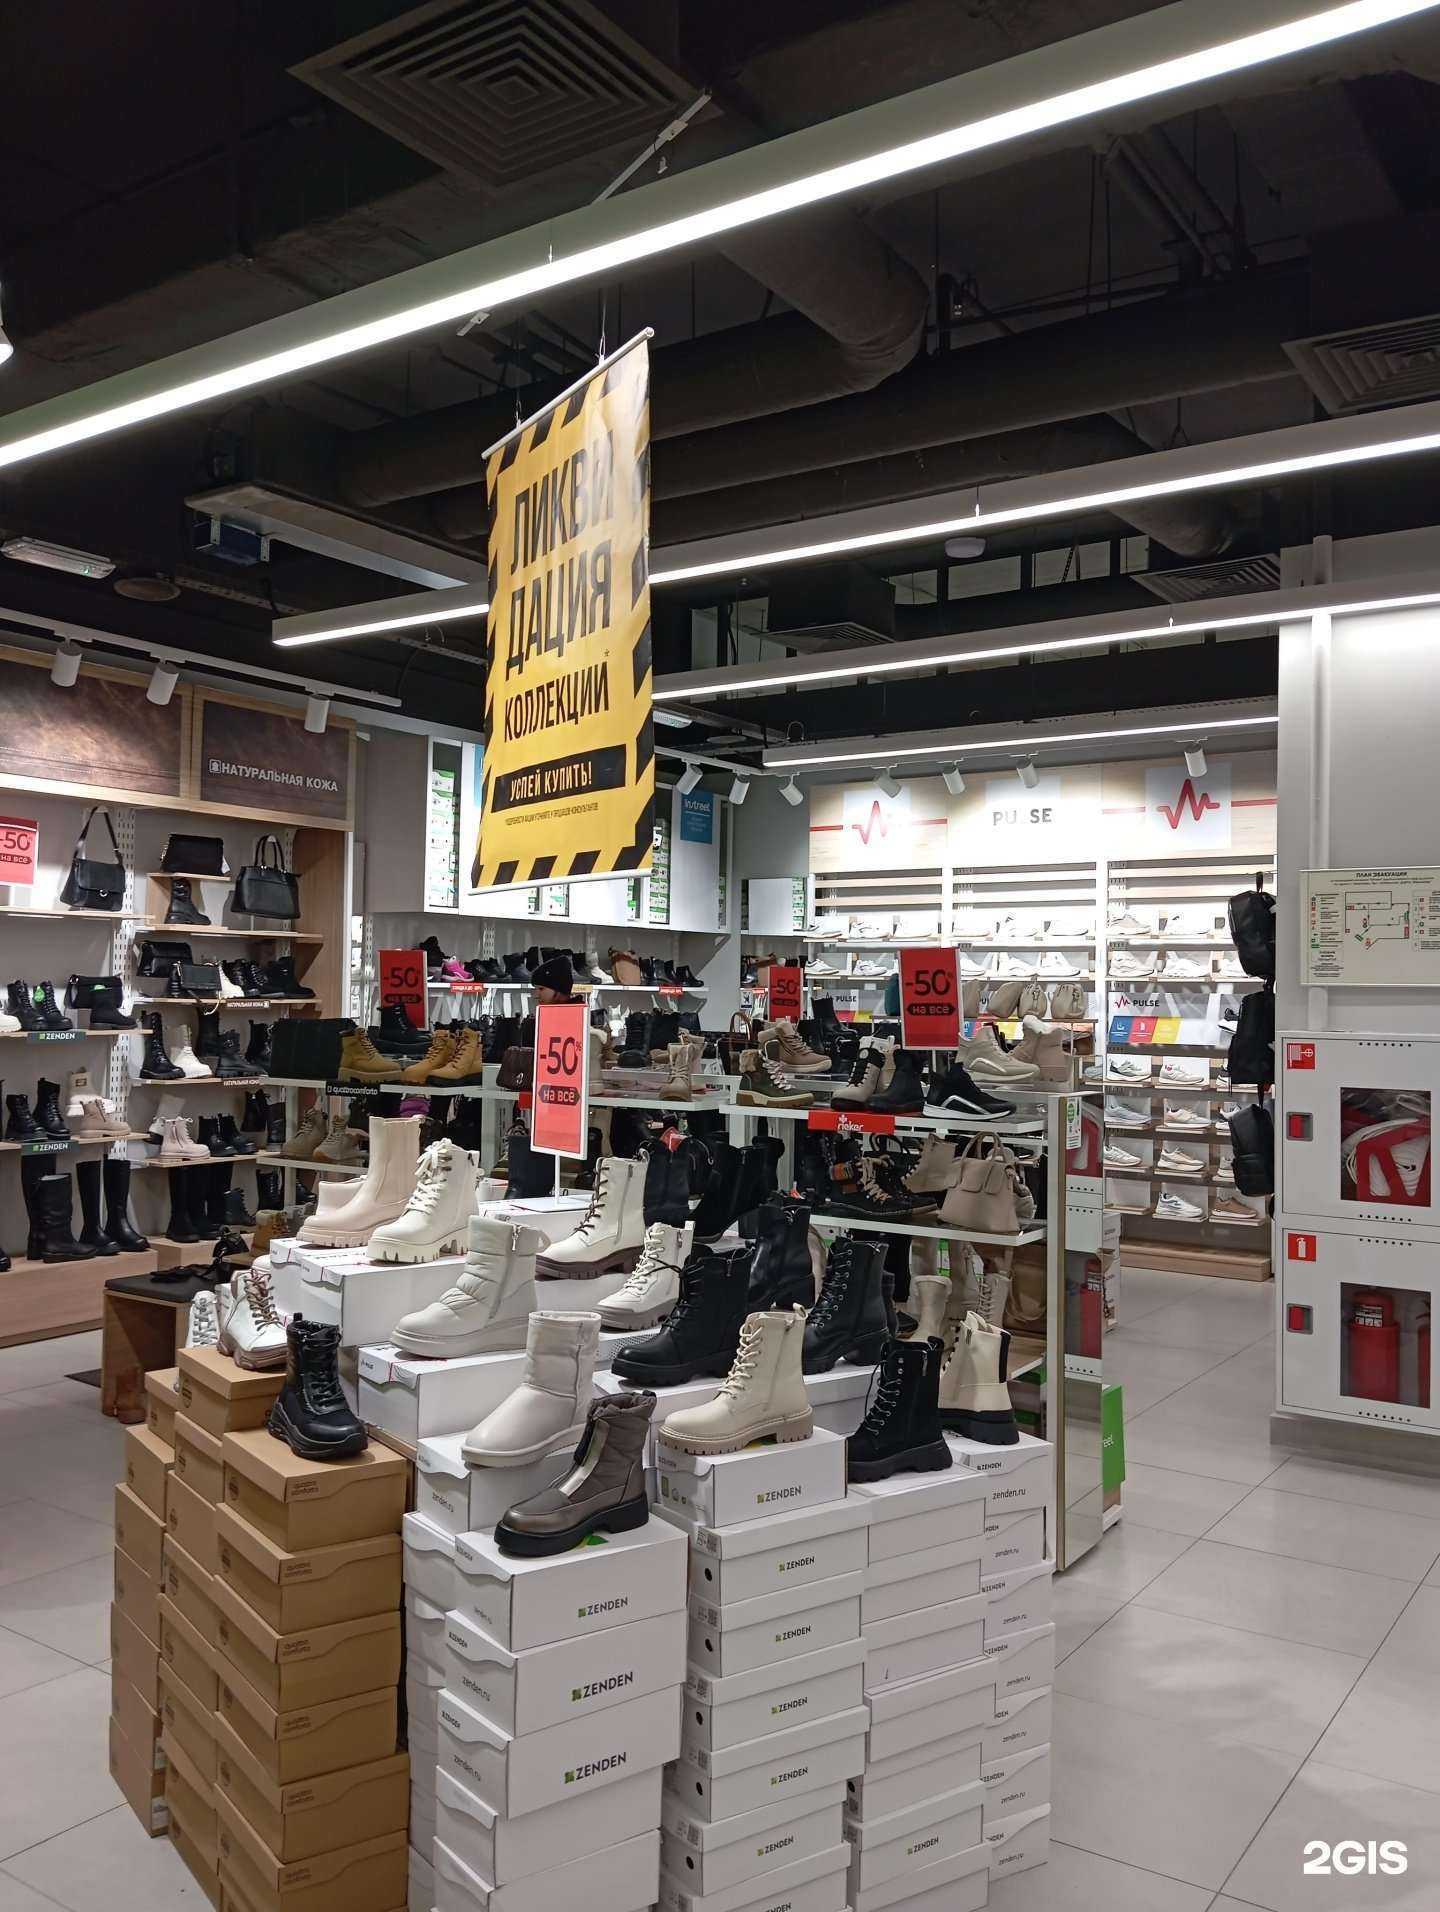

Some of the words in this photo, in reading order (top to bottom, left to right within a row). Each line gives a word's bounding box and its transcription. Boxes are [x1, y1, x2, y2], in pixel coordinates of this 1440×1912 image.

[511, 430, 613, 576] ЛИКВИ
[506, 540, 611, 681] ДАЦИЯ
[222, 763, 303, 786] НАТУРАЛЬНАЯ
[306, 777, 338, 791] КОЖА
[510, 768, 540, 802] УСПЕЙ
[545, 761, 592, 794] КУПИТЬ!
[993, 808, 1052, 826] PUSE
[1132, 999, 1160, 1007] PULSE
[46, 1032, 75, 1040] ZENDEN
[540, 1037, 582, 1075] -50%
[837, 1121, 864, 1132] rieker
[39, 1143, 68, 1152] ZENDEN
[765, 1486, 801, 1502] ZENDEN
[992, 1488, 1026, 1500] zenden.ru
[786, 1556, 815, 1570] ZENDEN
[587, 1597, 628, 1616] ZENDEN
[782, 1625, 811, 1640] ZENDEN
[583, 1671, 633, 1698] ZENDEN
[778, 1697, 808, 1713] ZENDEN
[576, 1752, 627, 1780] ZENDEN
[778, 1767, 808, 1783] ZENDEN
[765, 1836, 794, 1854] ZENDEN
[914, 1837, 939, 1853] ZENDEN
